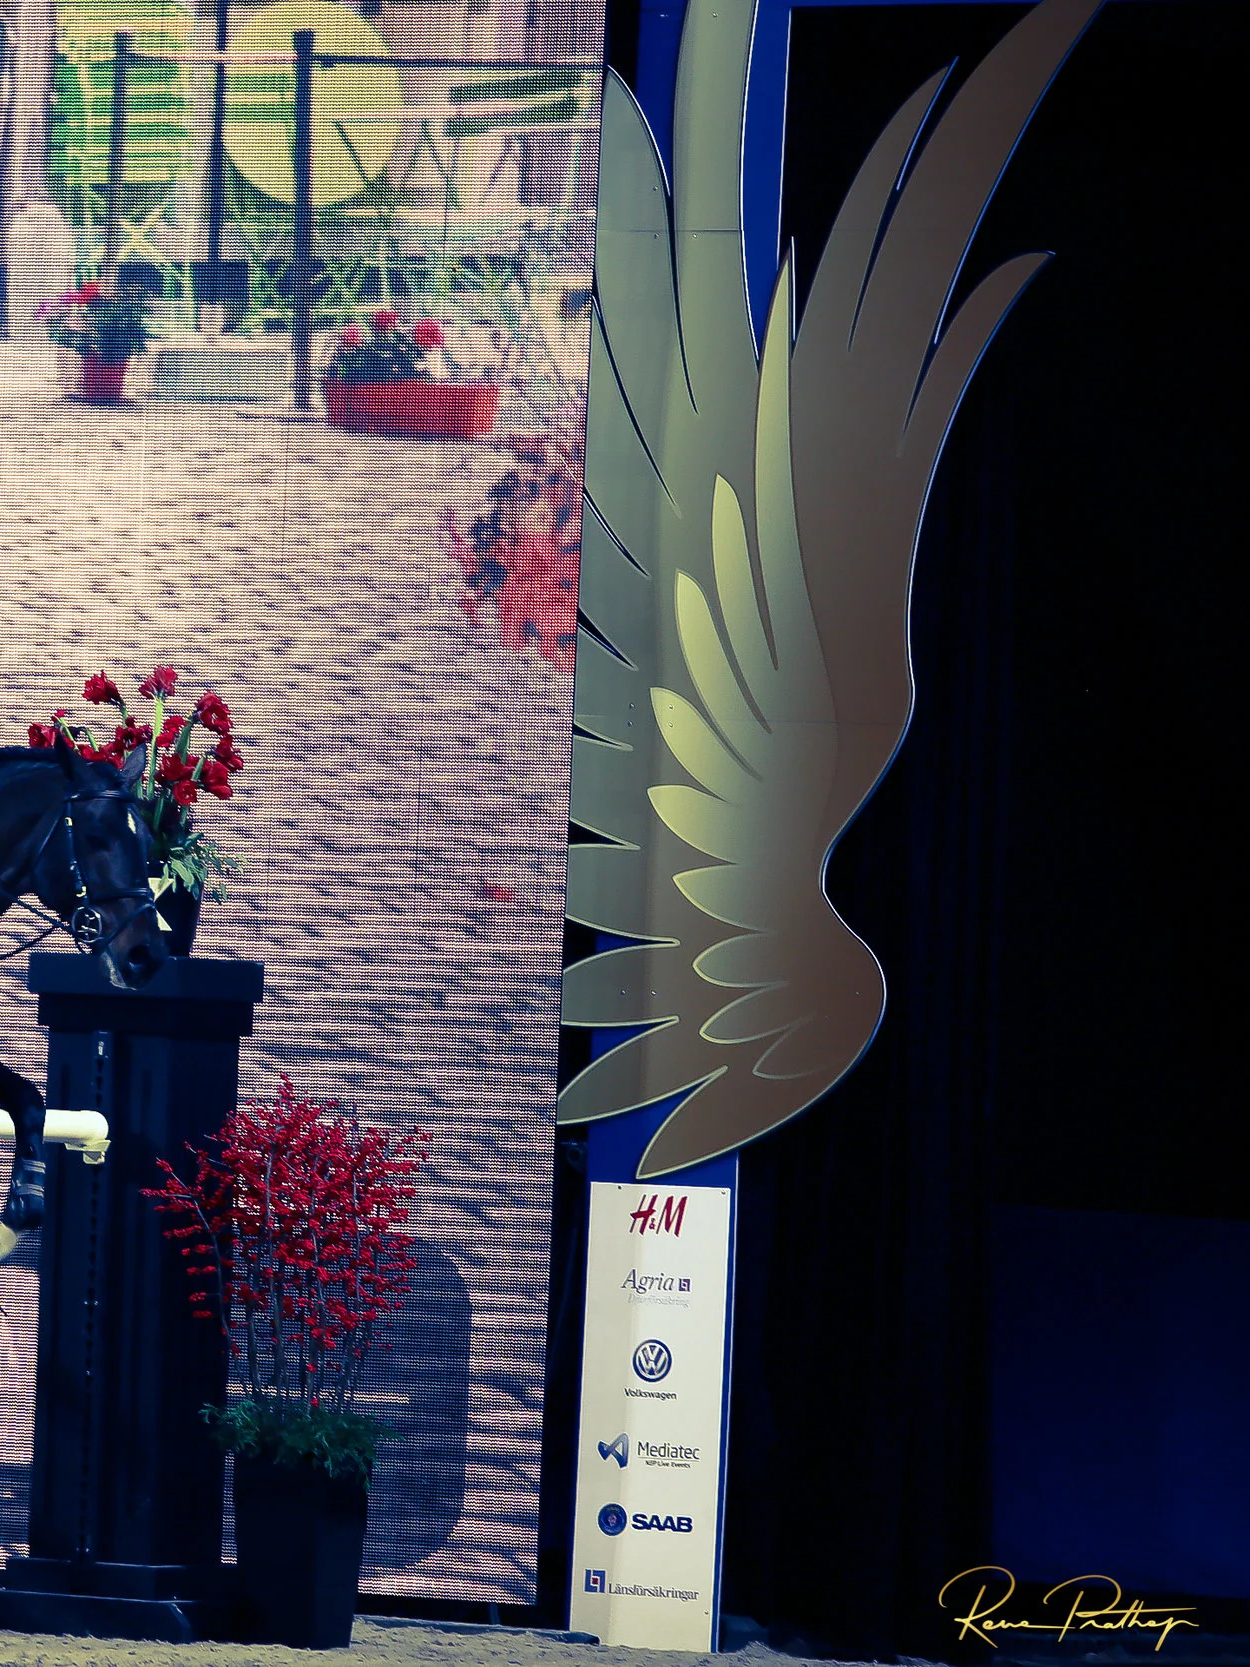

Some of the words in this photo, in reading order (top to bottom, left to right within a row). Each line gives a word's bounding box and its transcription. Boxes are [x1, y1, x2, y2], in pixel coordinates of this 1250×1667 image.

[629, 1194, 688, 1237] H&M
[621, 1269, 675, 1294] Agria
[624, 1388, 677, 1400] Volkswagen
[638, 1441, 700, 1460] Mediatec
[631, 1513, 693, 1533] SAAB
[608, 1583, 699, 1602] Länsförsäkringar
